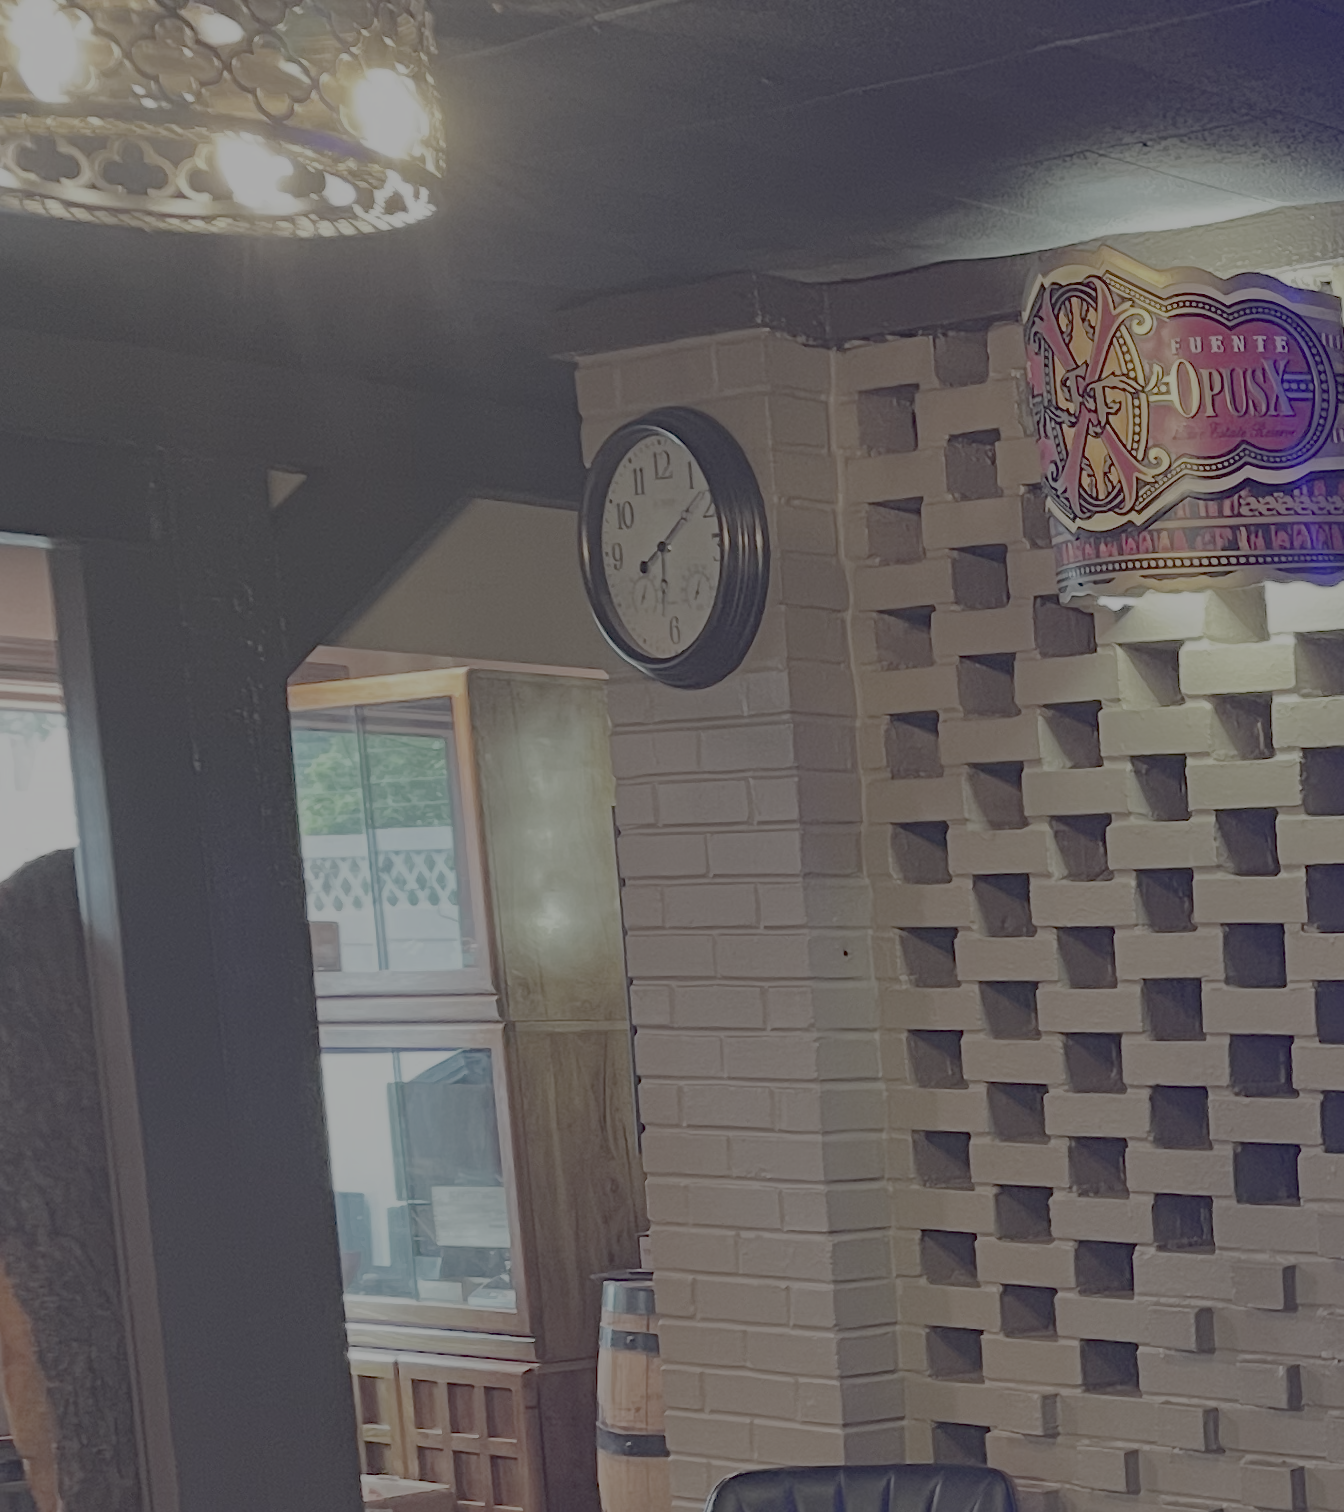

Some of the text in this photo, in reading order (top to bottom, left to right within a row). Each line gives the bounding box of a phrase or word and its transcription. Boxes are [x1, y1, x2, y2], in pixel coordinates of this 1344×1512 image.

[1170, 335, 1289, 355] FUENTE
[653, 450, 673, 480] 12
[633, 467, 645, 496] 11
[616, 501, 635, 530] 10
[611, 542, 624, 571] 9
[669, 616, 681, 645] 6
